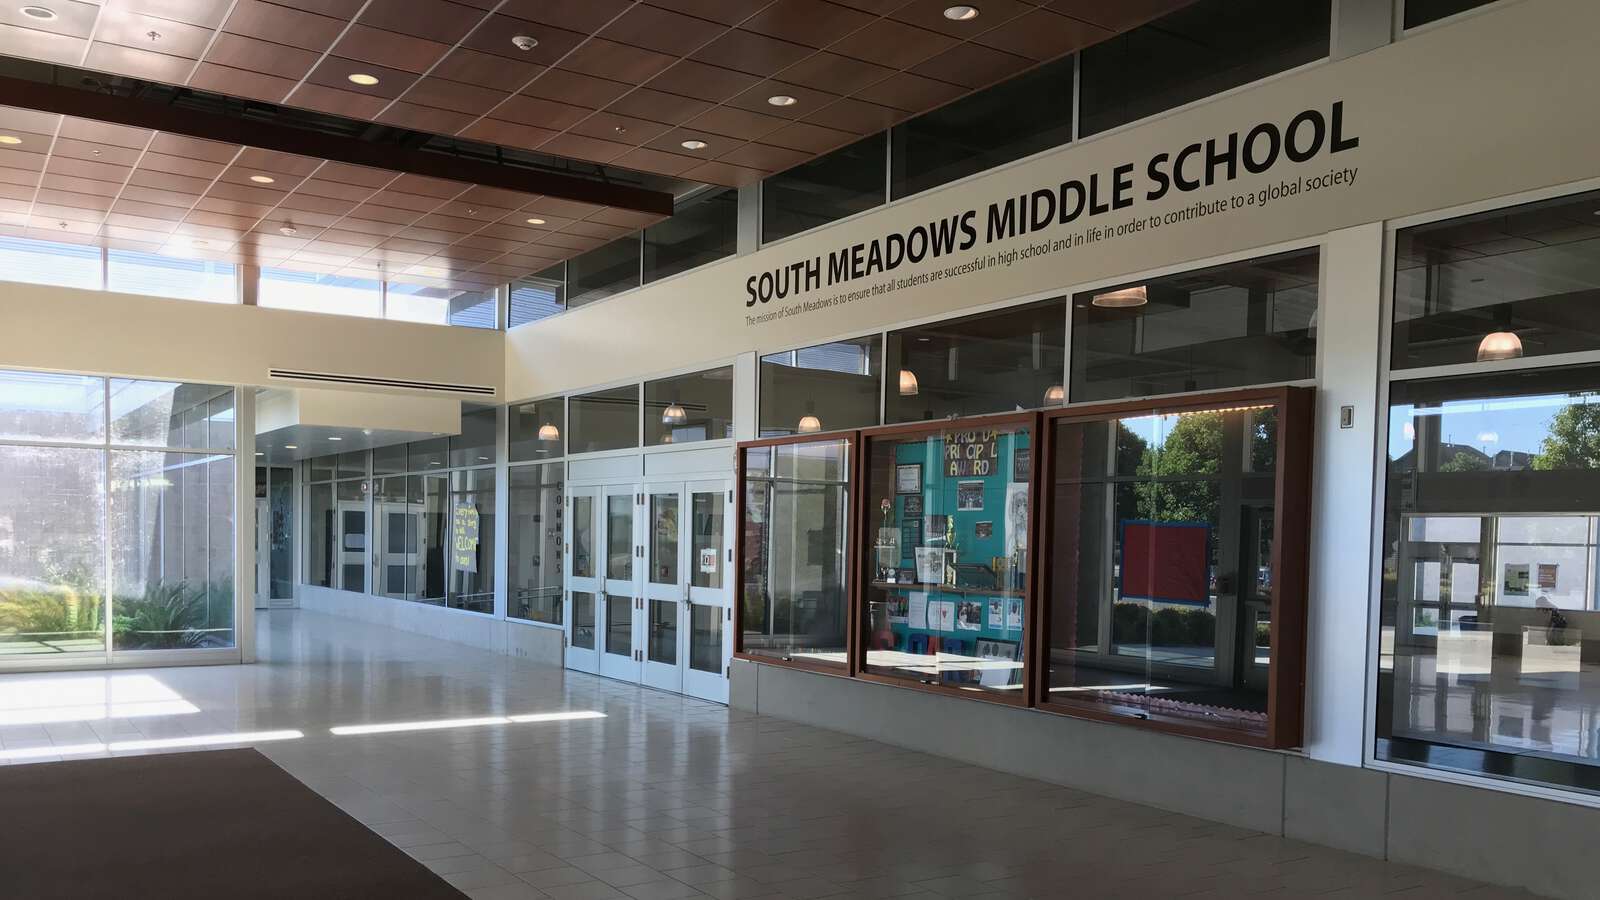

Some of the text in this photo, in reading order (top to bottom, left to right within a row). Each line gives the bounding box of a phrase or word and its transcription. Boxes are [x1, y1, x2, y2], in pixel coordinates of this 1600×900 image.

[745, 167, 1359, 327] The mission of South Meadows is to ensure that all students are successful in high school and in life in order to contribute to a global society
[746, 99, 1360, 308] SOUTH MEADOWS MIDDLE SCHOOL
[556, 481, 564, 574] COMMONS
